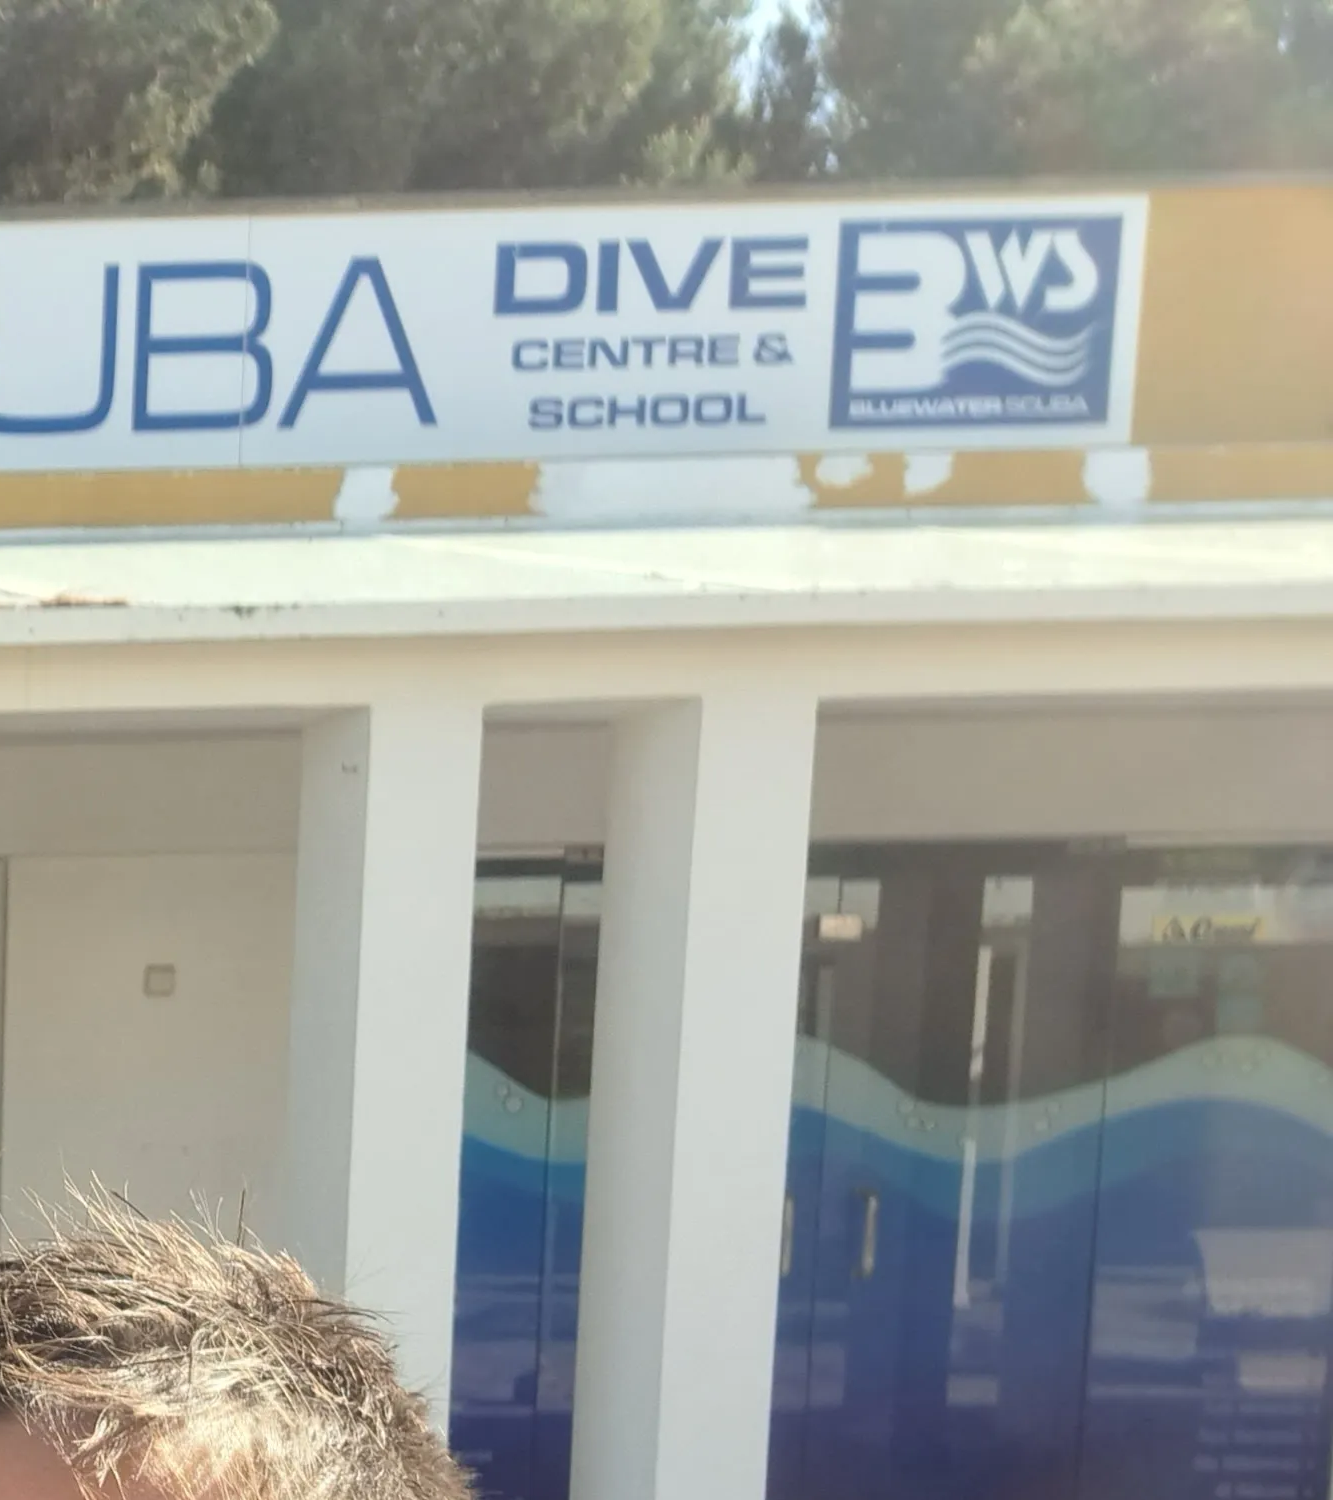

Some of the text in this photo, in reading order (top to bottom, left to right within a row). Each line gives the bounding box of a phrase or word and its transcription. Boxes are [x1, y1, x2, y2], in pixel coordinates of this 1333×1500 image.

[494, 235, 809, 315] DIVE
[511, 334, 794, 373] CENTRE &
[527, 393, 767, 430] SCHOOL
